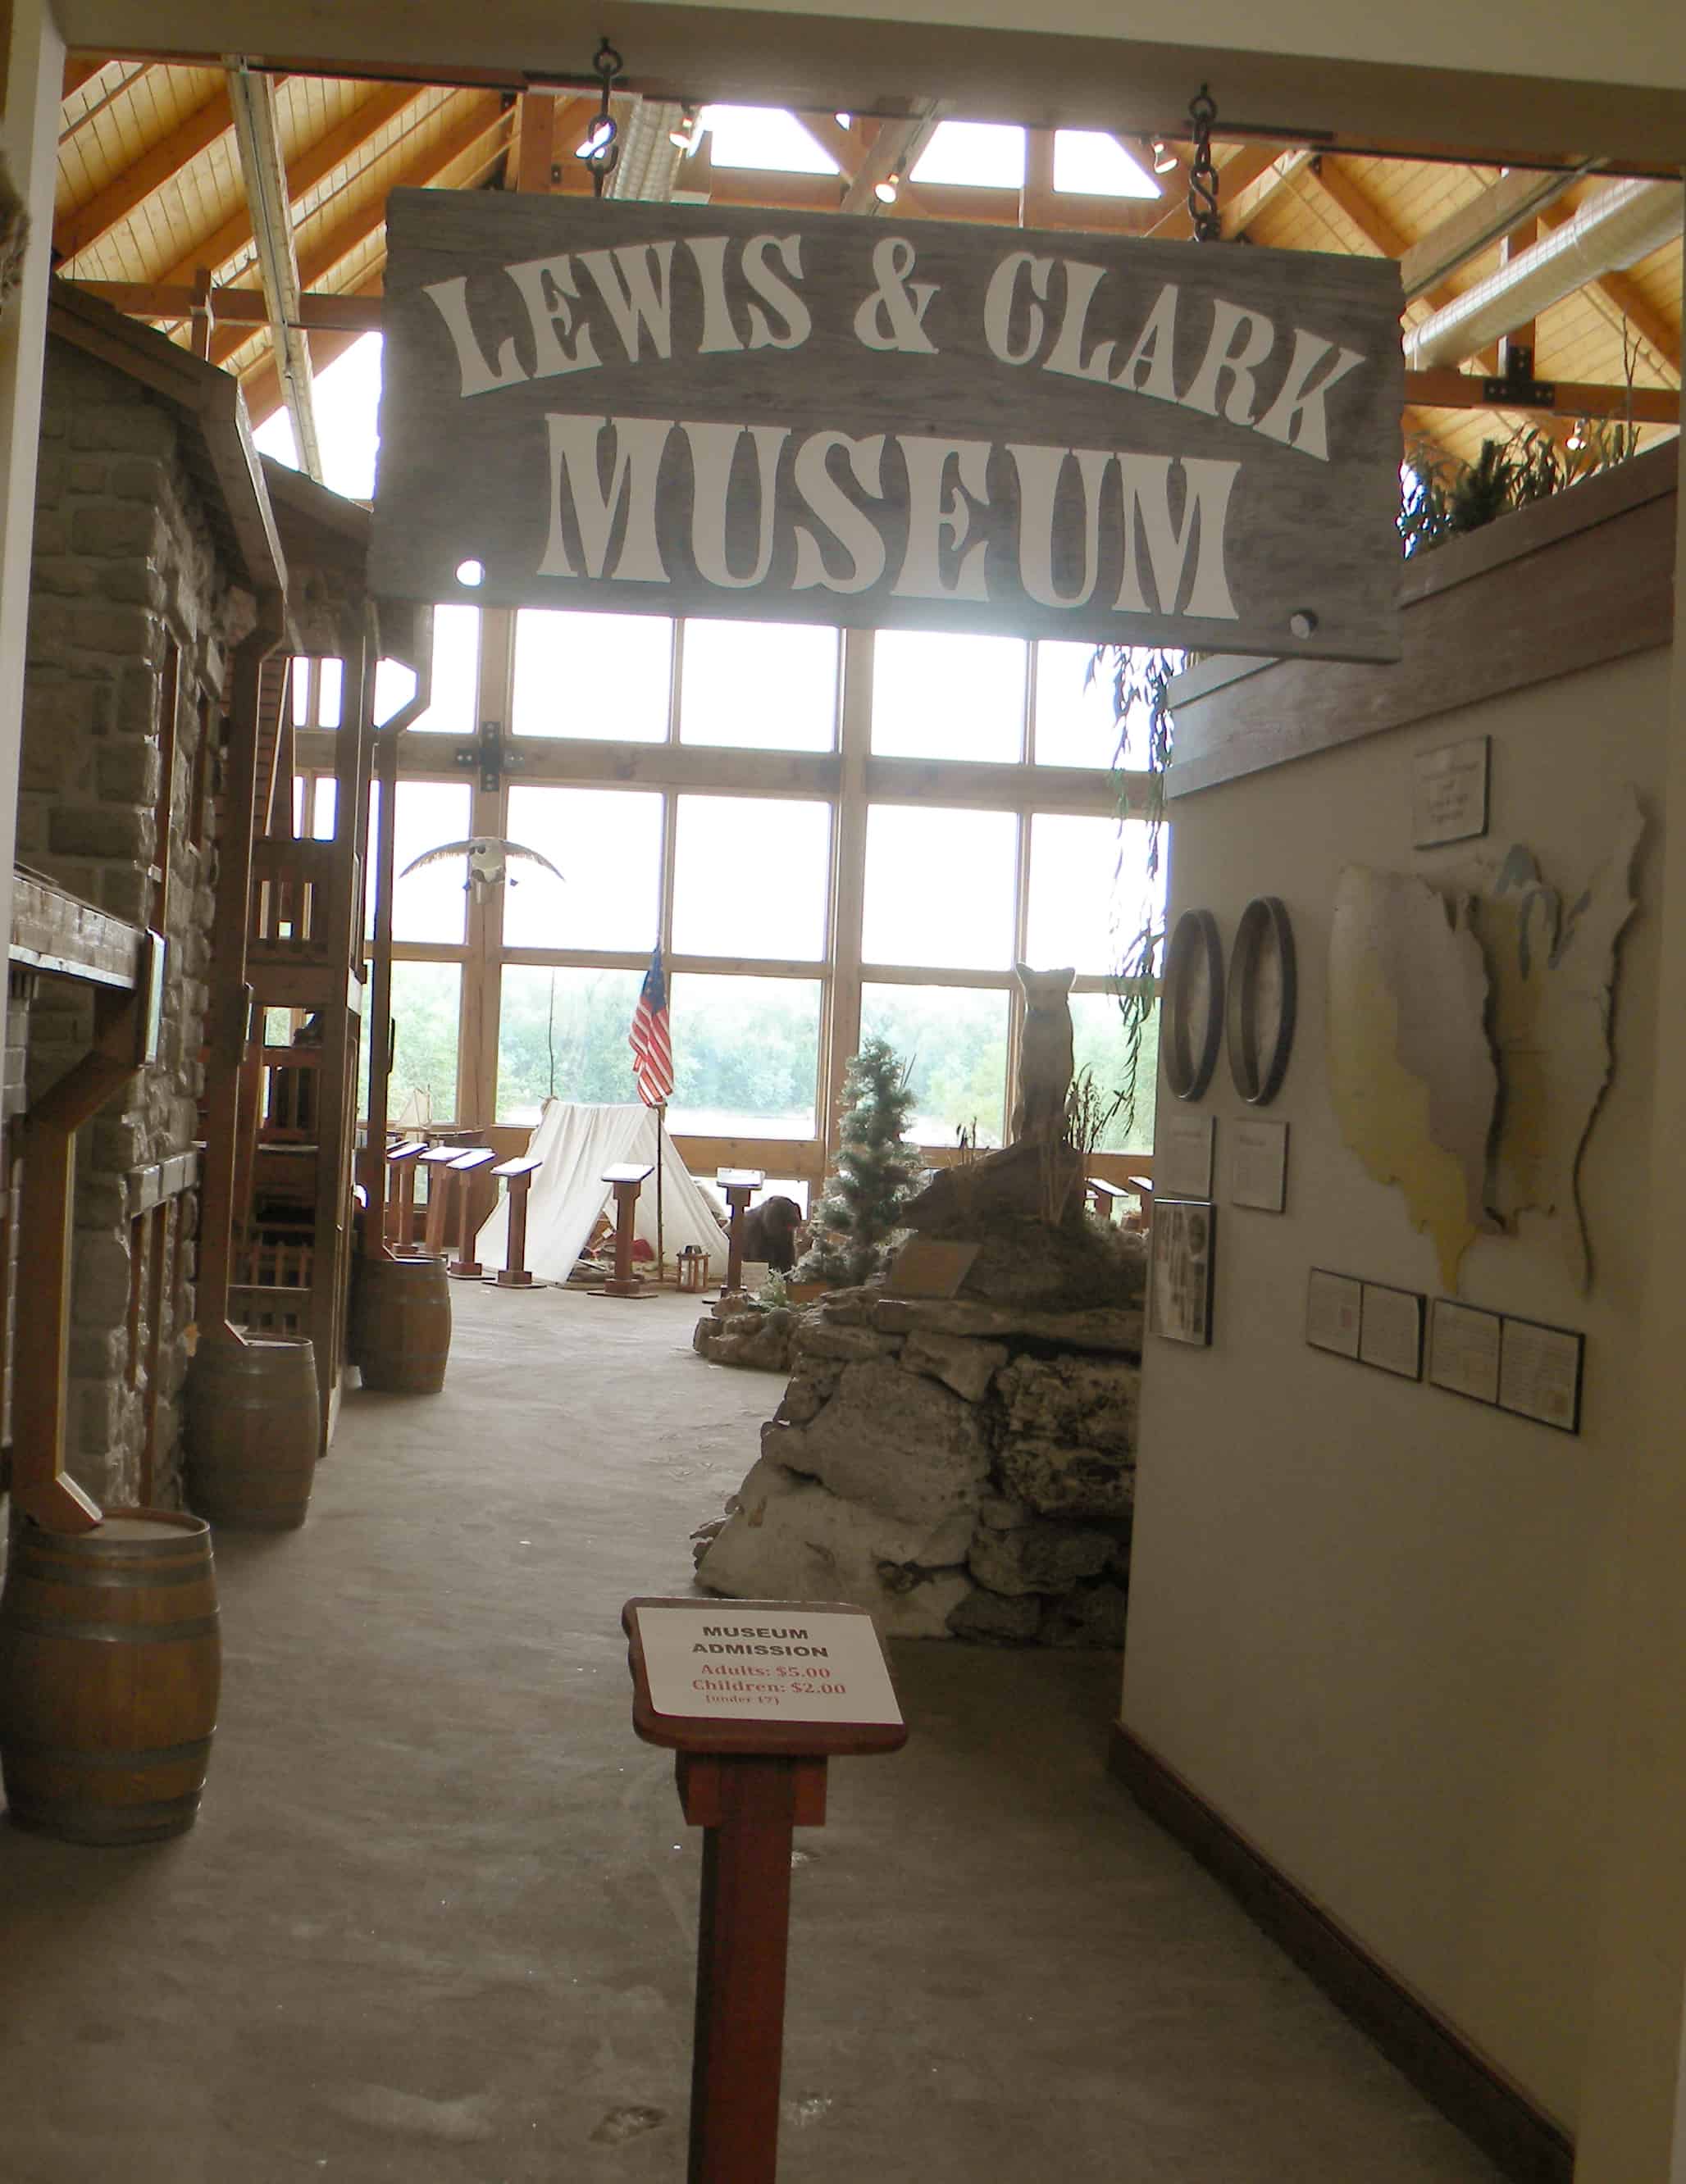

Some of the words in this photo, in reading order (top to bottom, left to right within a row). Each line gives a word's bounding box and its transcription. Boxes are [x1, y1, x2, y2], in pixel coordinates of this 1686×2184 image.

[422, 233, 812, 398] LEWIS
[854, 235, 940, 355] &
[983, 251, 1367, 462] CLARK
[535, 412, 1242, 621] MUSEUM
[702, 1626, 809, 1640] MUSEUM
[692, 1643, 829, 1658] ADMISSION
[701, 1664, 771, 1677] Adults:
[776, 1666, 831, 1678] $5.00
[692, 1679, 786, 1693] Children:
[791, 1681, 846, 1695] $2.00
